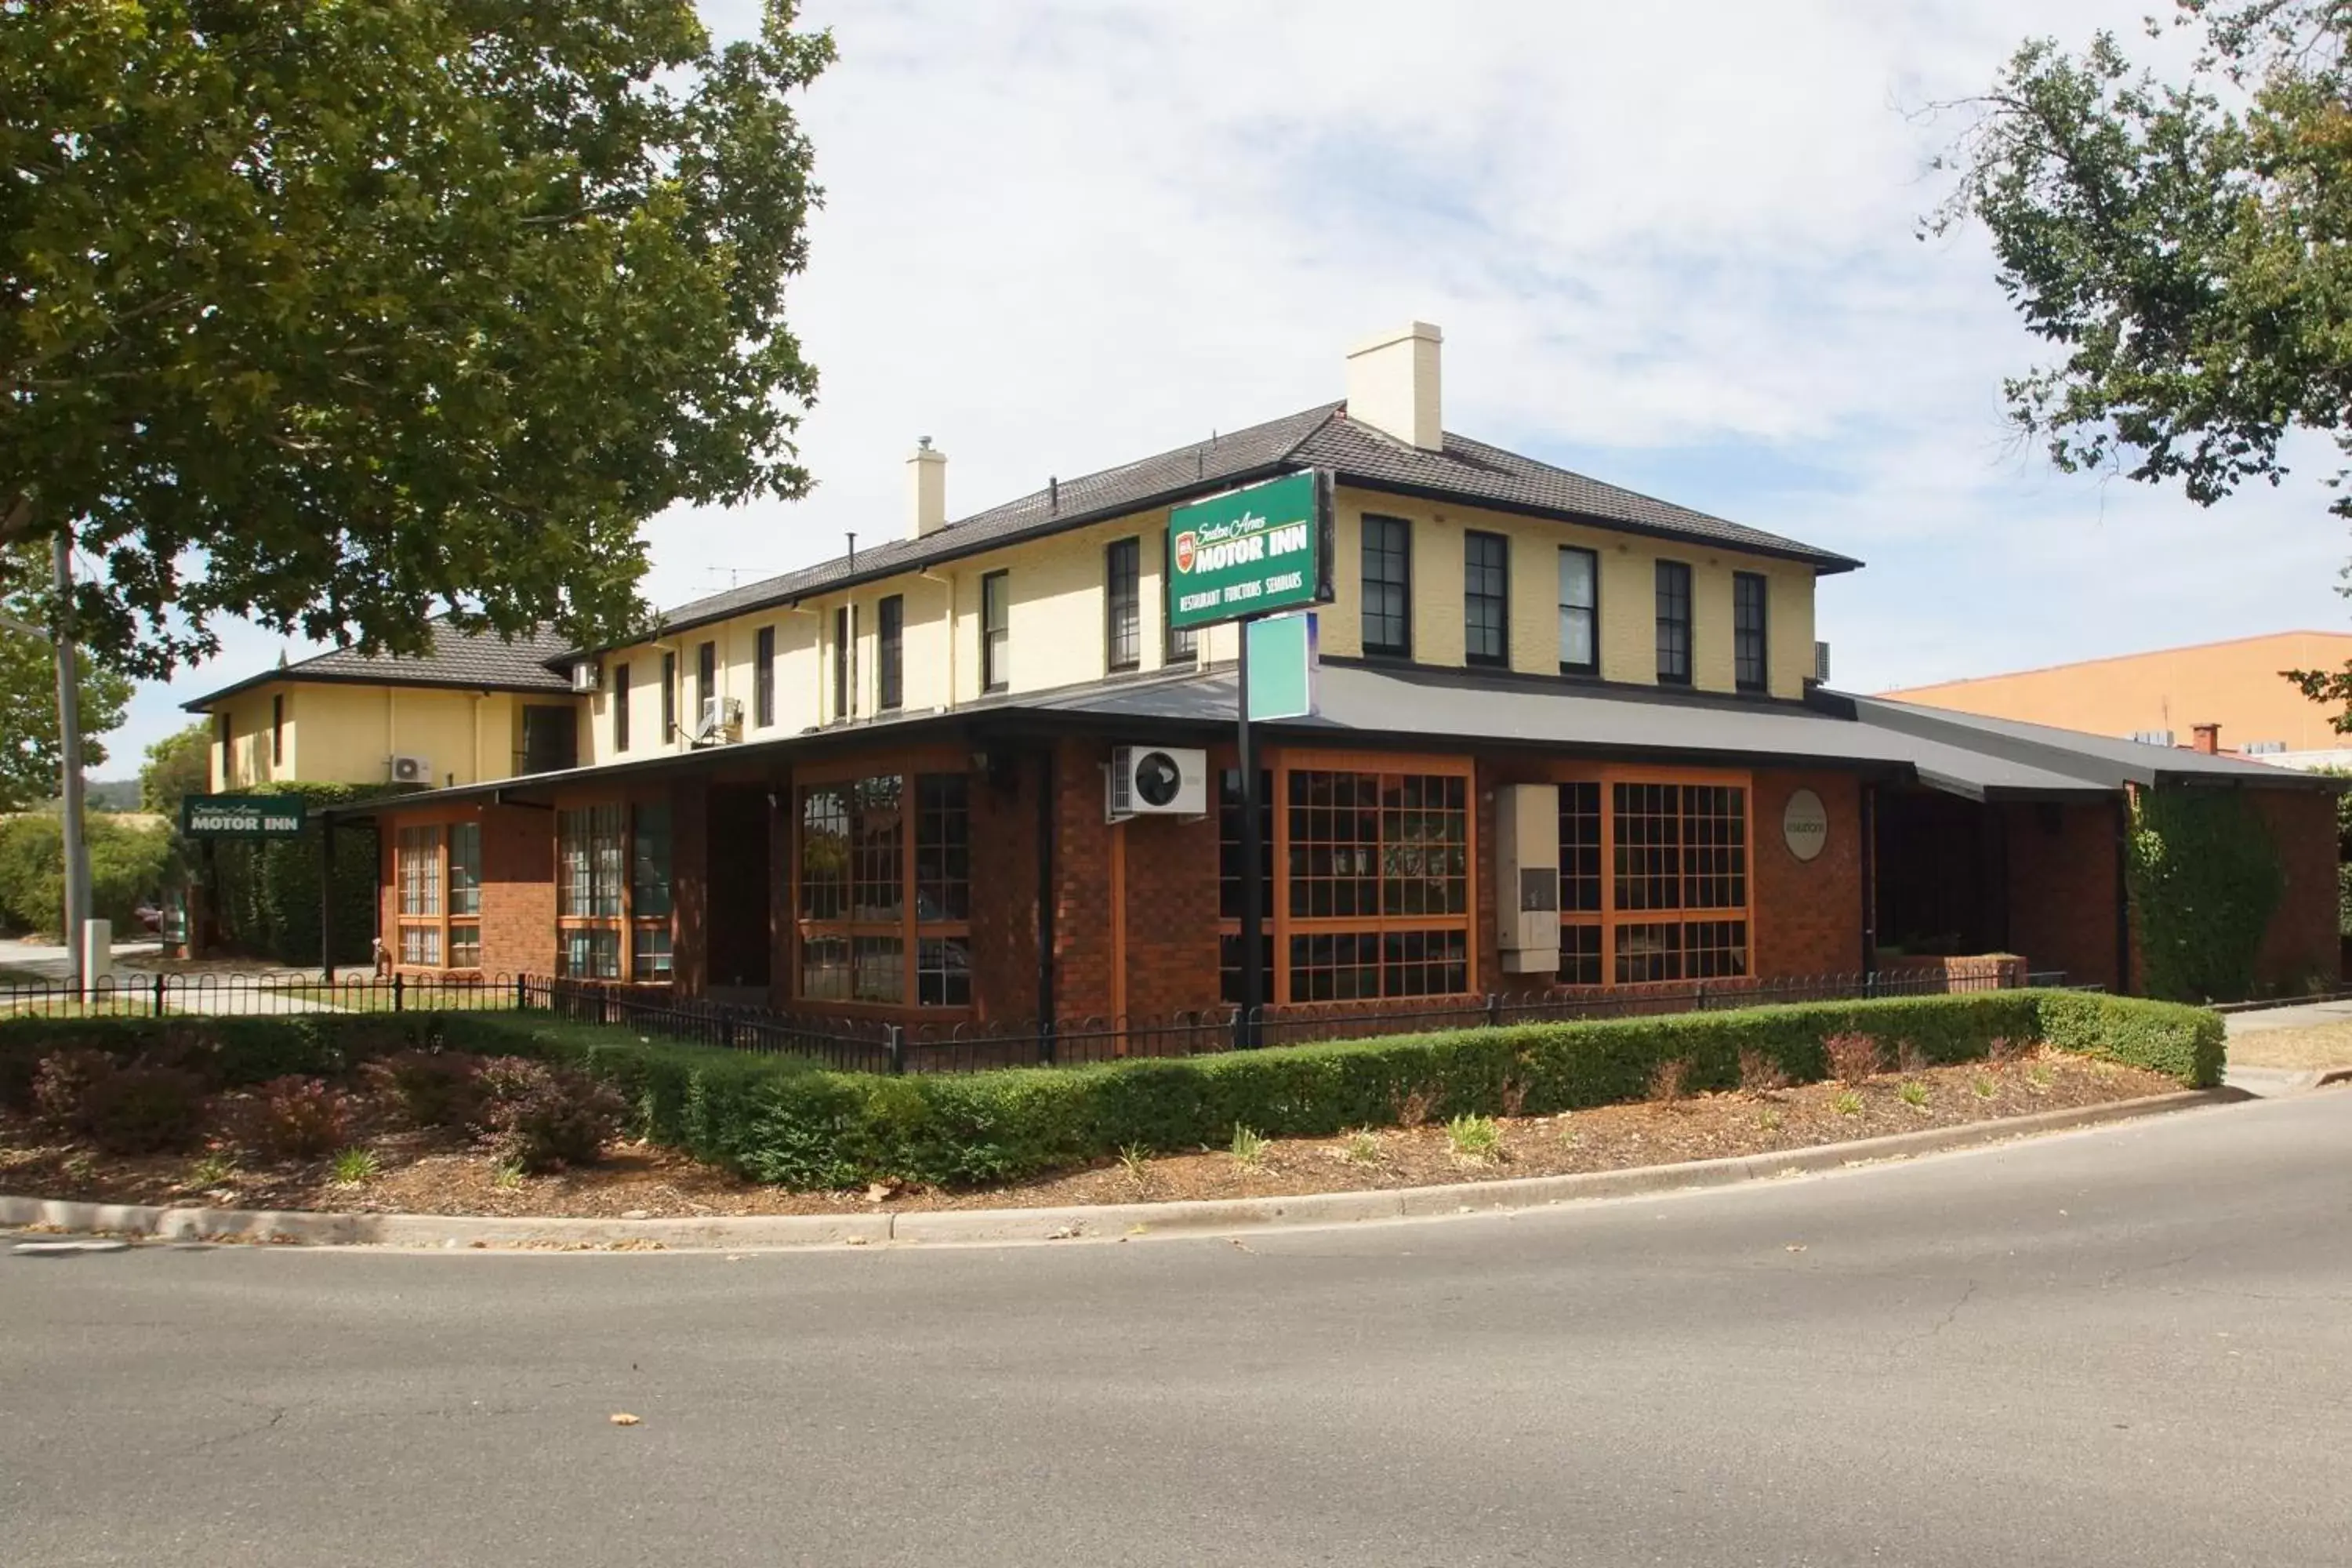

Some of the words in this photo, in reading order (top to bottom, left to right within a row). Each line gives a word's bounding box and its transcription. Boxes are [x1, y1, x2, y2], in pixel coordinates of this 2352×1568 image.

[1229, 510, 1267, 538] Arms
[1196, 535, 1265, 574] MOTOR
[1269, 524, 1307, 557] INN
[1180, 589, 1221, 612] RESTAURANT
[1224, 579, 1261, 602] FUNCTIONS
[1265, 571, 1302, 594] SEMINARS
[191, 816, 259, 831] MOTOR
[263, 817, 299, 831] INN
